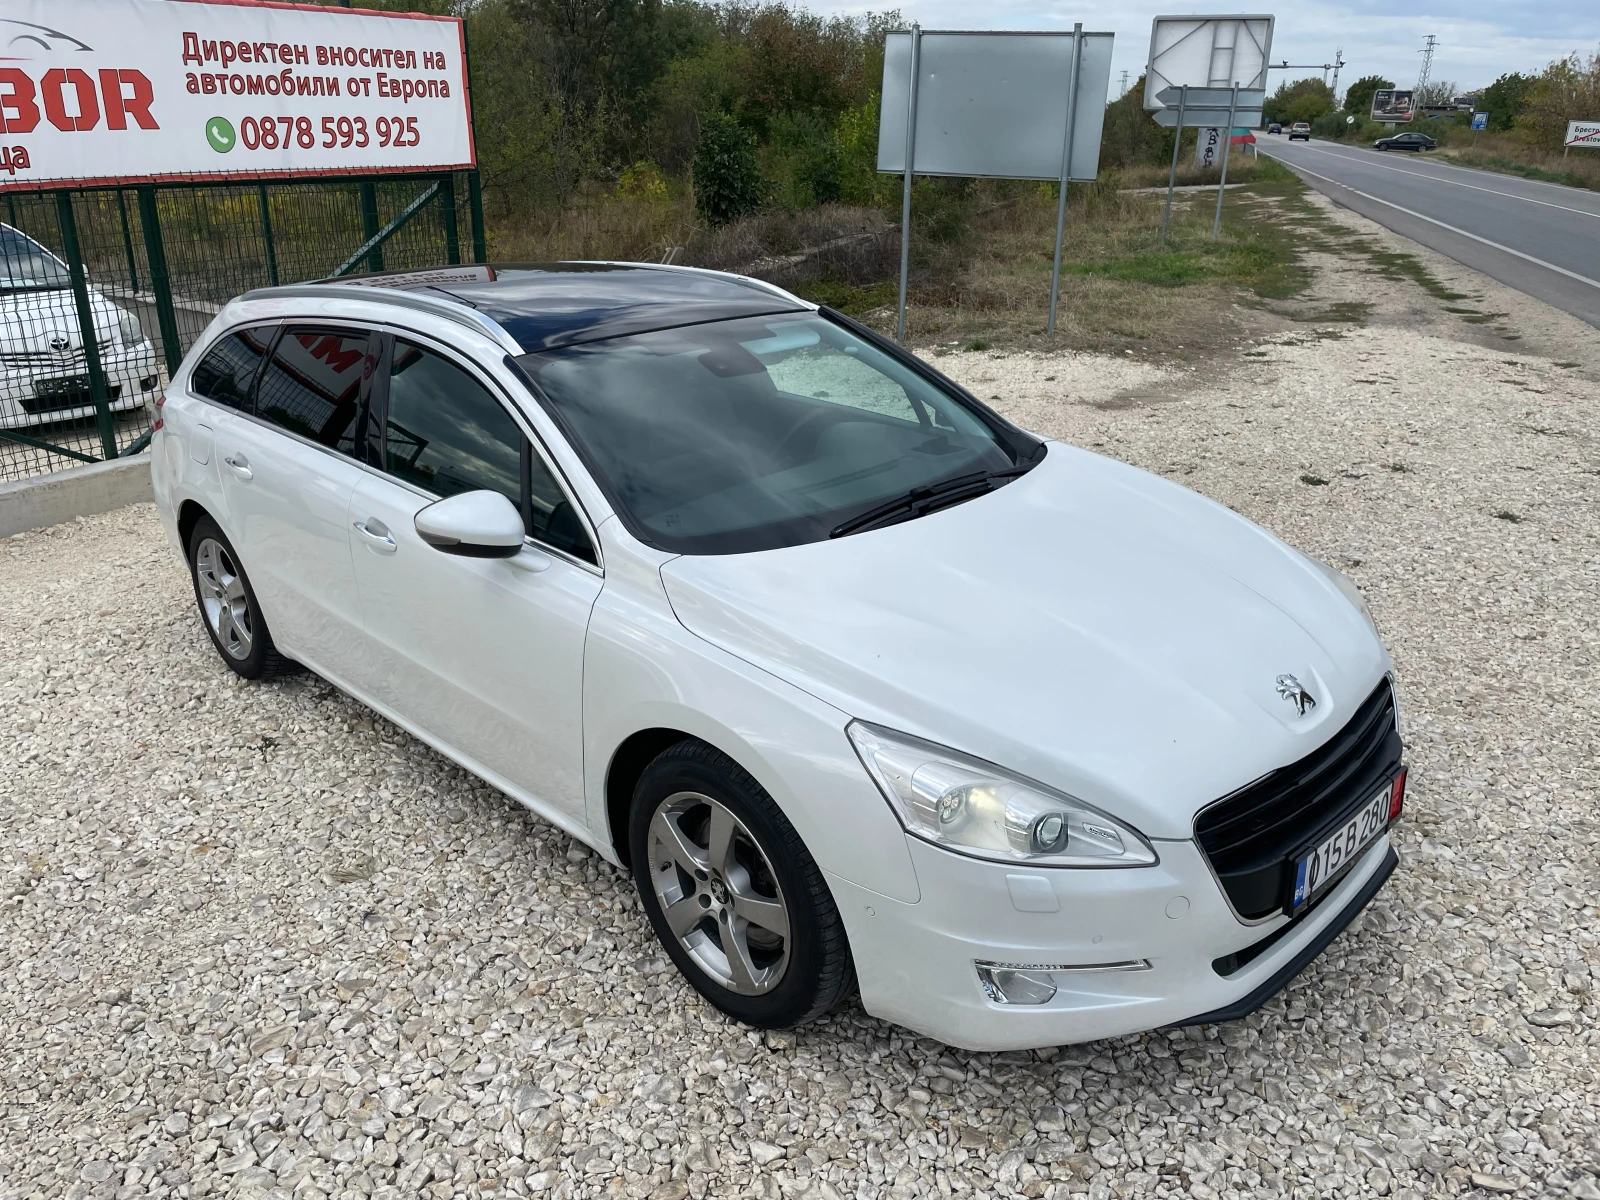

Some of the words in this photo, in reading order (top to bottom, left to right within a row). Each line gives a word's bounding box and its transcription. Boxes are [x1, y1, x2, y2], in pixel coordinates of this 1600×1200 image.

[182, 32, 309, 68] Директен
[316, 45, 416, 69] вносител
[422, 51, 446, 70] на
[185, 68, 340, 96] автомобили
[346, 77, 371, 97] от
[376, 72, 450, 103] Европа
[240, 116, 315, 150] 0878
[321, 116, 370, 148] 593
[375, 116, 420, 147] 925
